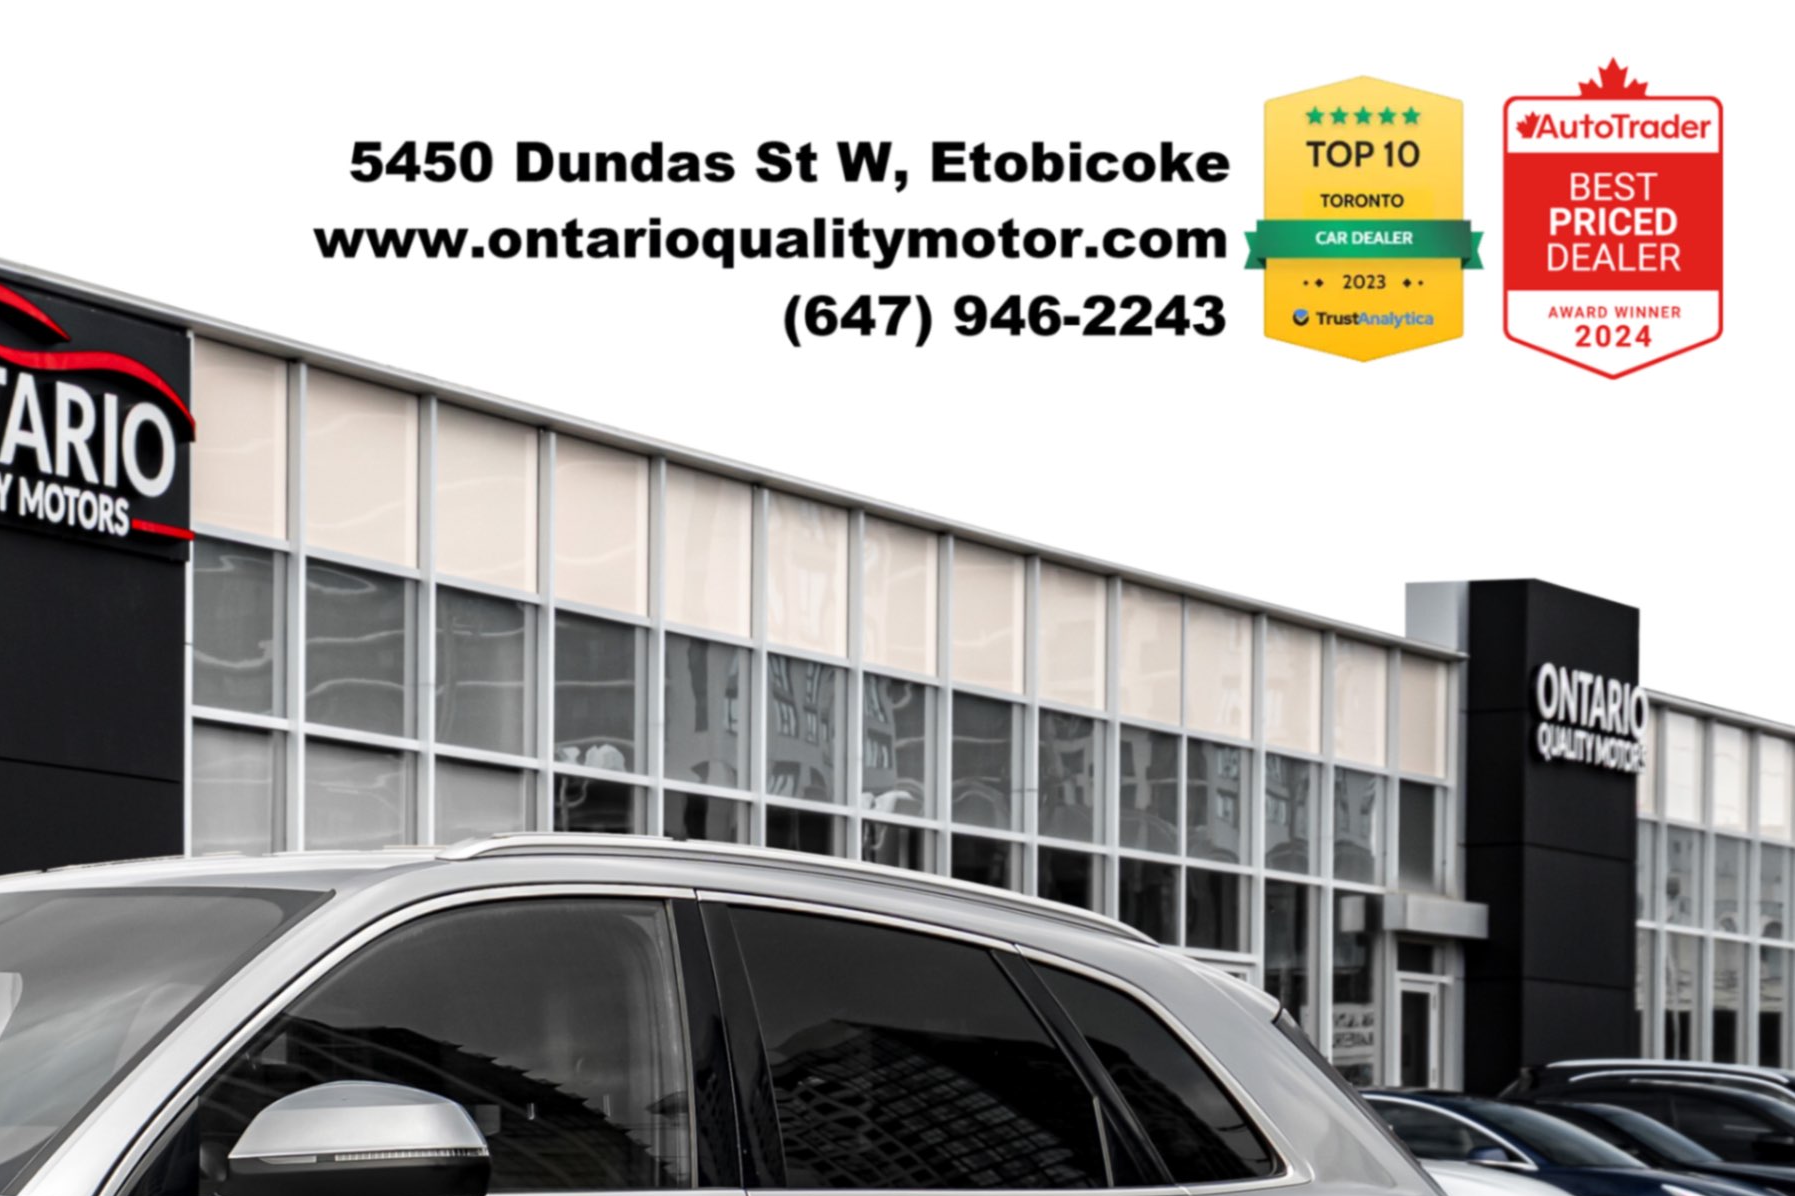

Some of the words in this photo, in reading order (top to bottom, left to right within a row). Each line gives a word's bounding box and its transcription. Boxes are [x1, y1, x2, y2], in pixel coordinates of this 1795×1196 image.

[17, 475, 131, 538] MOTORS
[1536, 661, 1650, 741] ONTARIO
[1536, 721, 1595, 764] QUALITY
